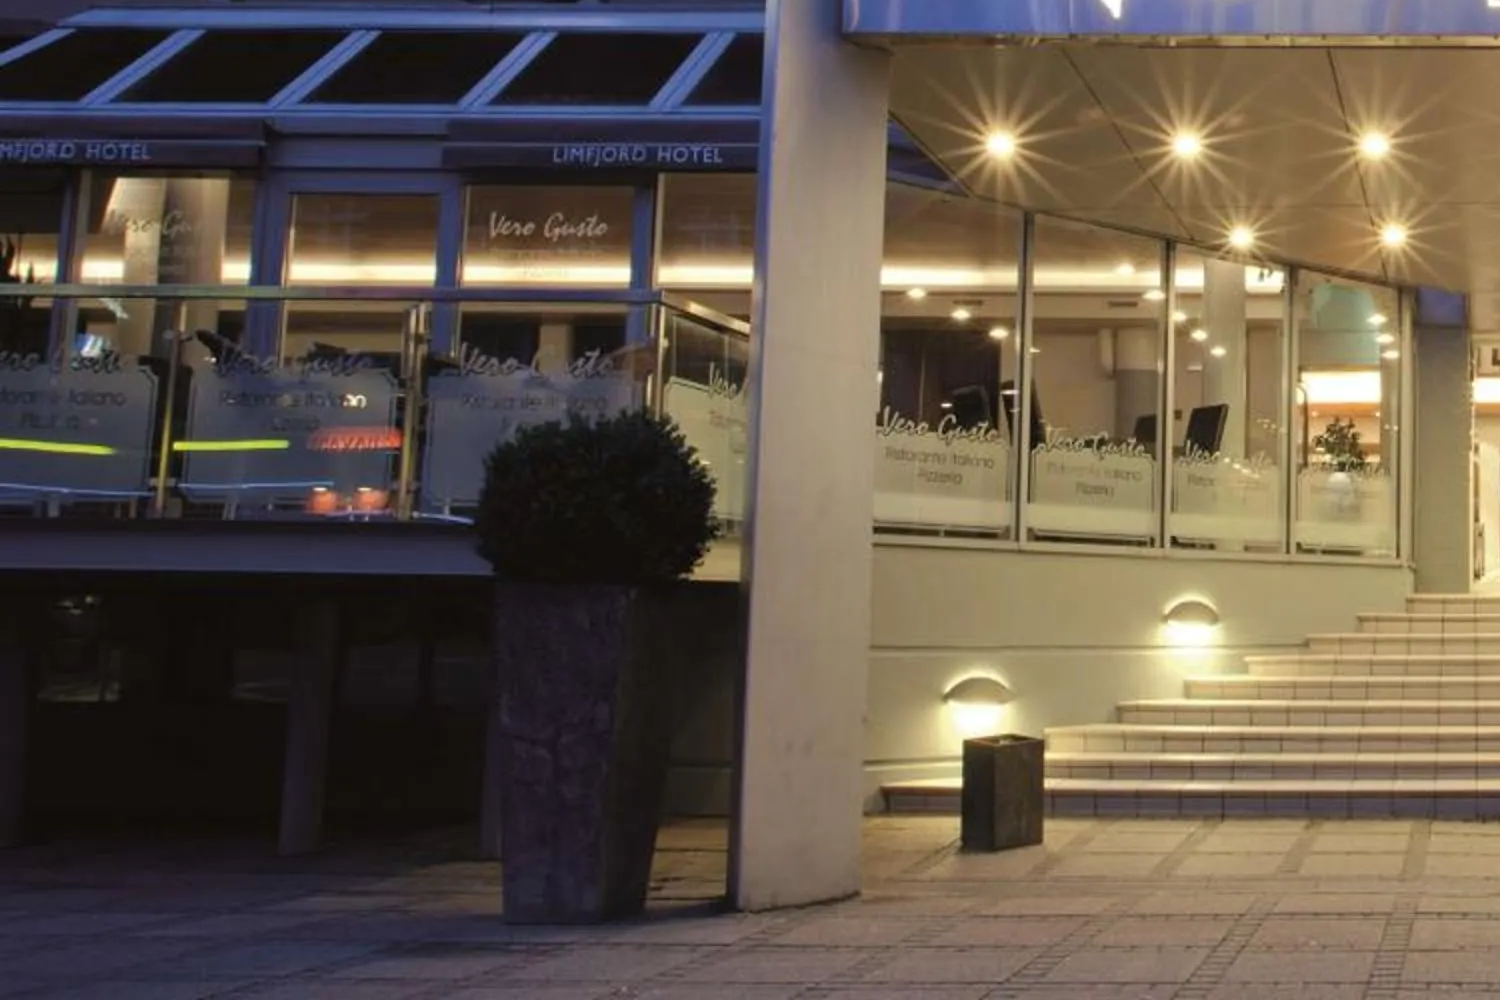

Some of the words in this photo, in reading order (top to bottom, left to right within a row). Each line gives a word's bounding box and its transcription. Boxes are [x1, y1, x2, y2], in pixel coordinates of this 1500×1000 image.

[86, 143, 152, 161] HOTEL
[552, 145, 647, 166] LIMFJORD
[657, 146, 724, 163] HOTEL
[488, 211, 536, 239] Vero
[543, 212, 608, 242] Gusto
[880, 405, 929, 437] Vero
[937, 413, 1000, 447] Gusto
